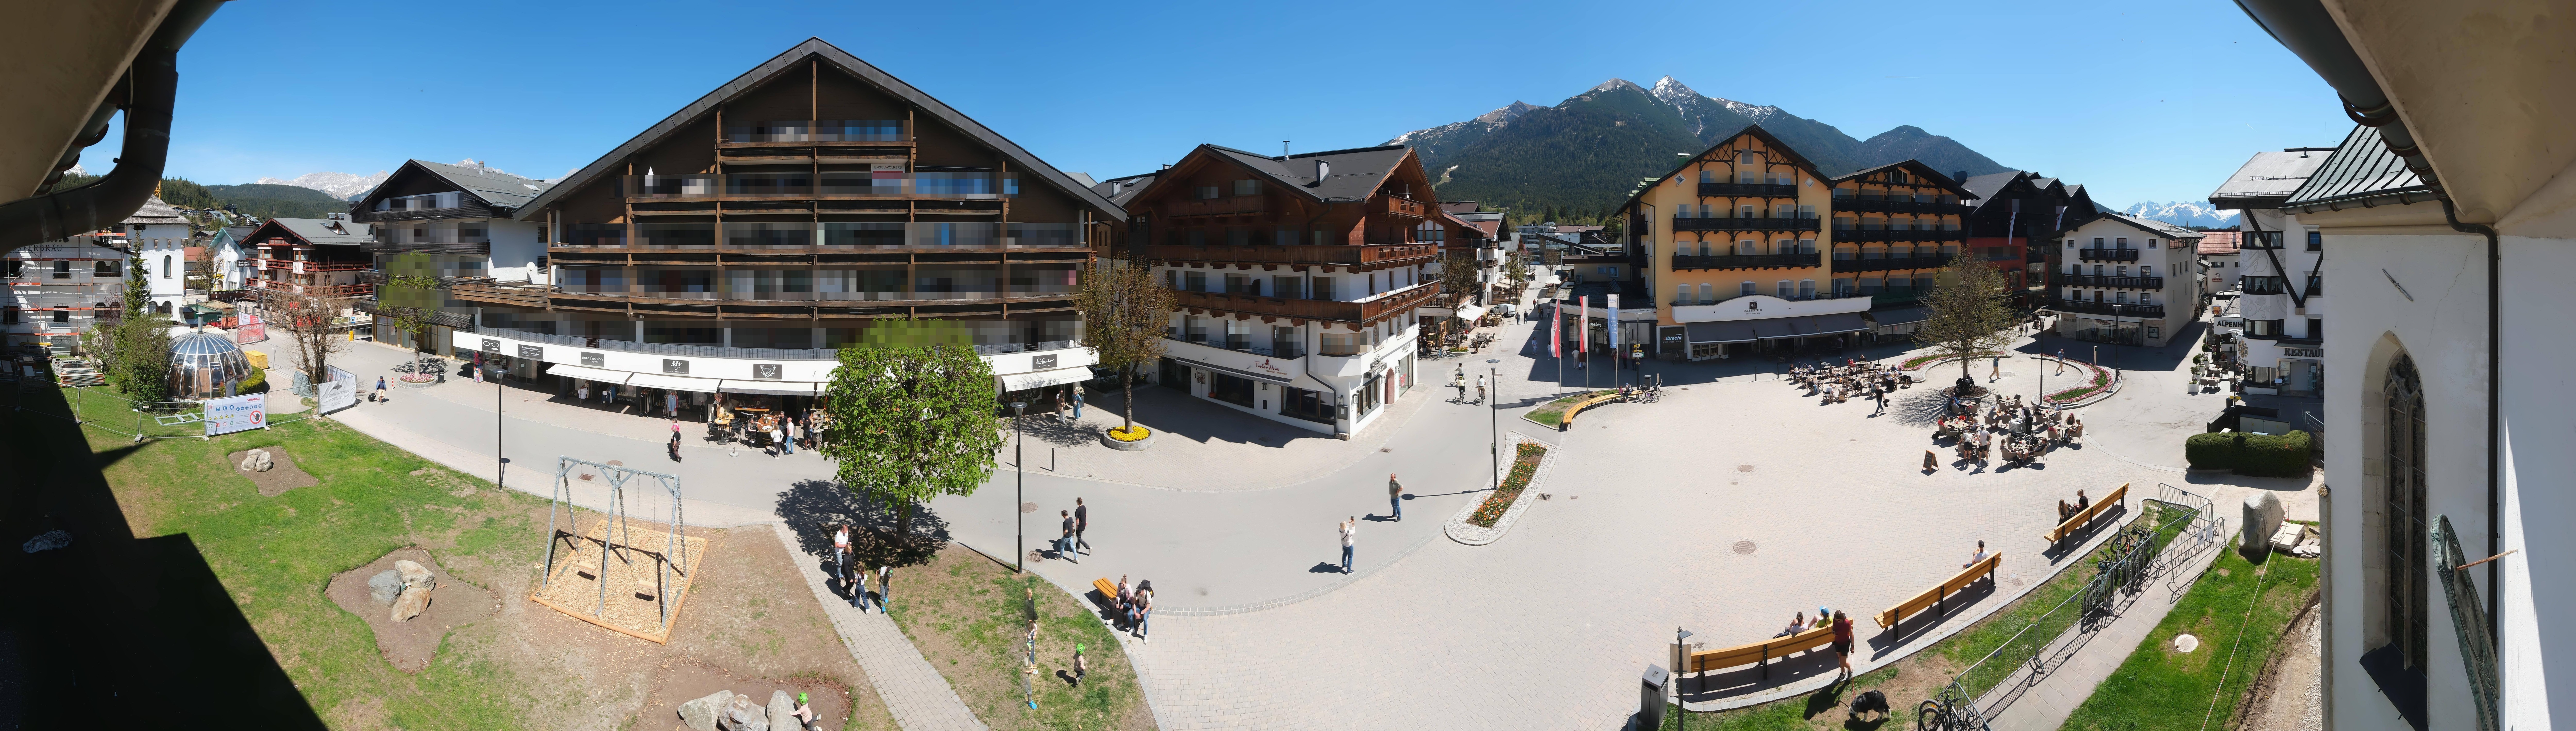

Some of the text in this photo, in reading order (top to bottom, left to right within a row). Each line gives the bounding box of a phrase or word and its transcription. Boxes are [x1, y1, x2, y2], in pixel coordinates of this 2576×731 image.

[671, 360, 682, 370] My
[1372, 364, 1386, 377] RESTAURANT
[326, 394, 349, 403] KONGRESSZENTRUM
